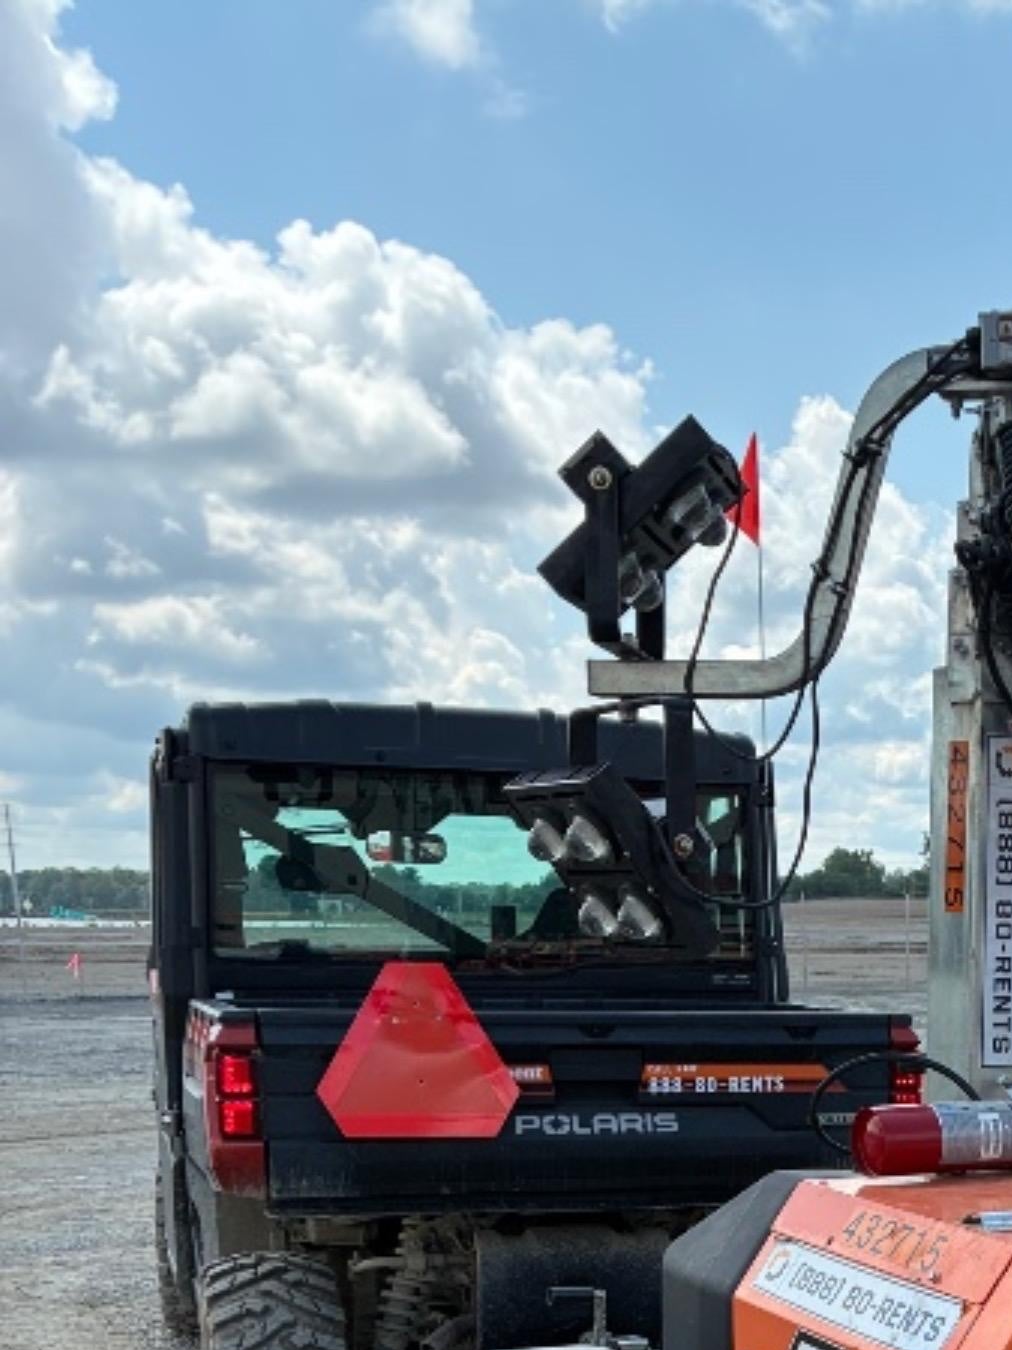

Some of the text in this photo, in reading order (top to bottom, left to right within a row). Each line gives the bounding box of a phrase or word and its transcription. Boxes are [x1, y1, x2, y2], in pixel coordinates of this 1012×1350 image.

[944, 746, 965, 907] 432715
[515, 1113, 679, 1135] POLARIS
[843, 1211, 949, 1272] 432715
[842, 1286, 946, 1342] 80-RENTS
